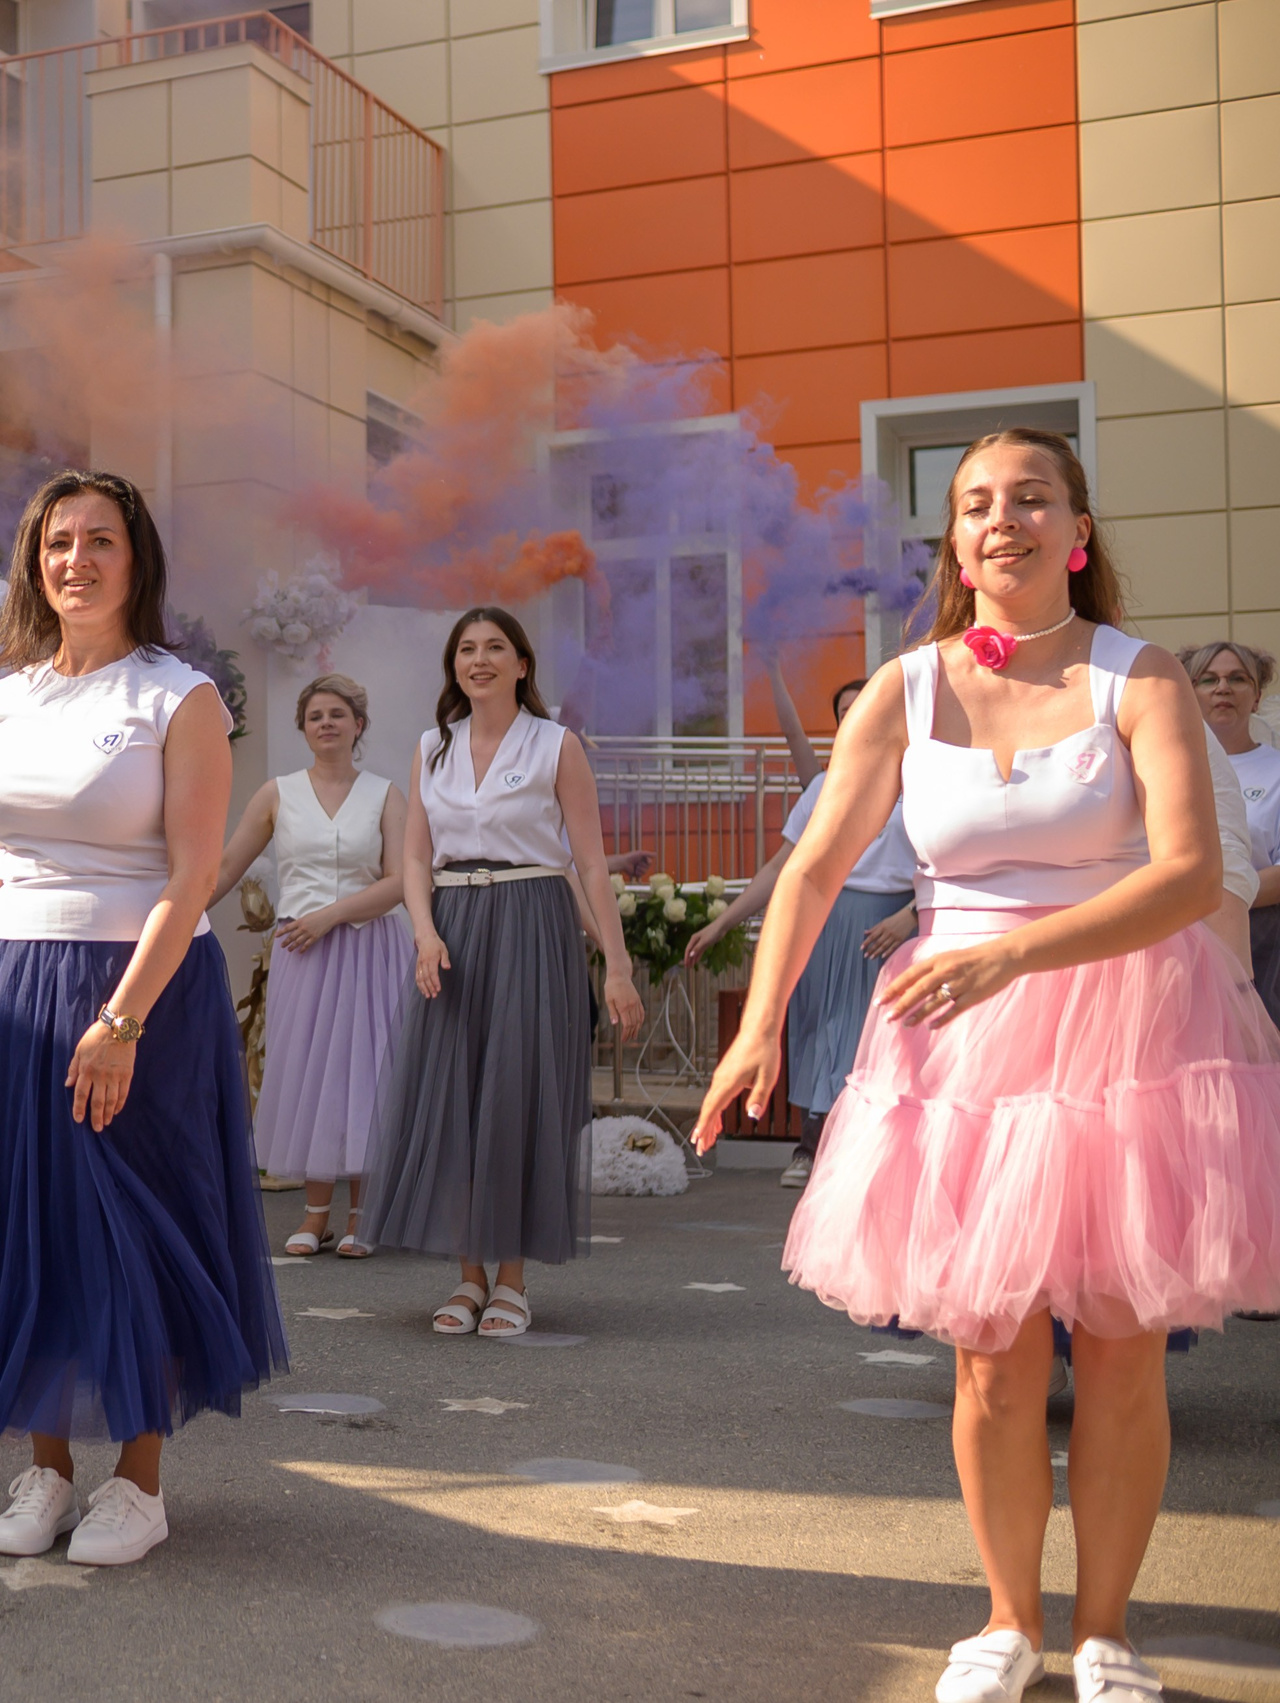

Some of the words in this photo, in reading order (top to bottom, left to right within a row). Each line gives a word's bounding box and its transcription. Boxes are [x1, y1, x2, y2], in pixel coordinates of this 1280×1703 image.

[101, 734, 119, 747] Я
[1075, 752, 1096, 770] Я
[510, 775, 522, 784] Я
[1250, 789, 1262, 798] Я
